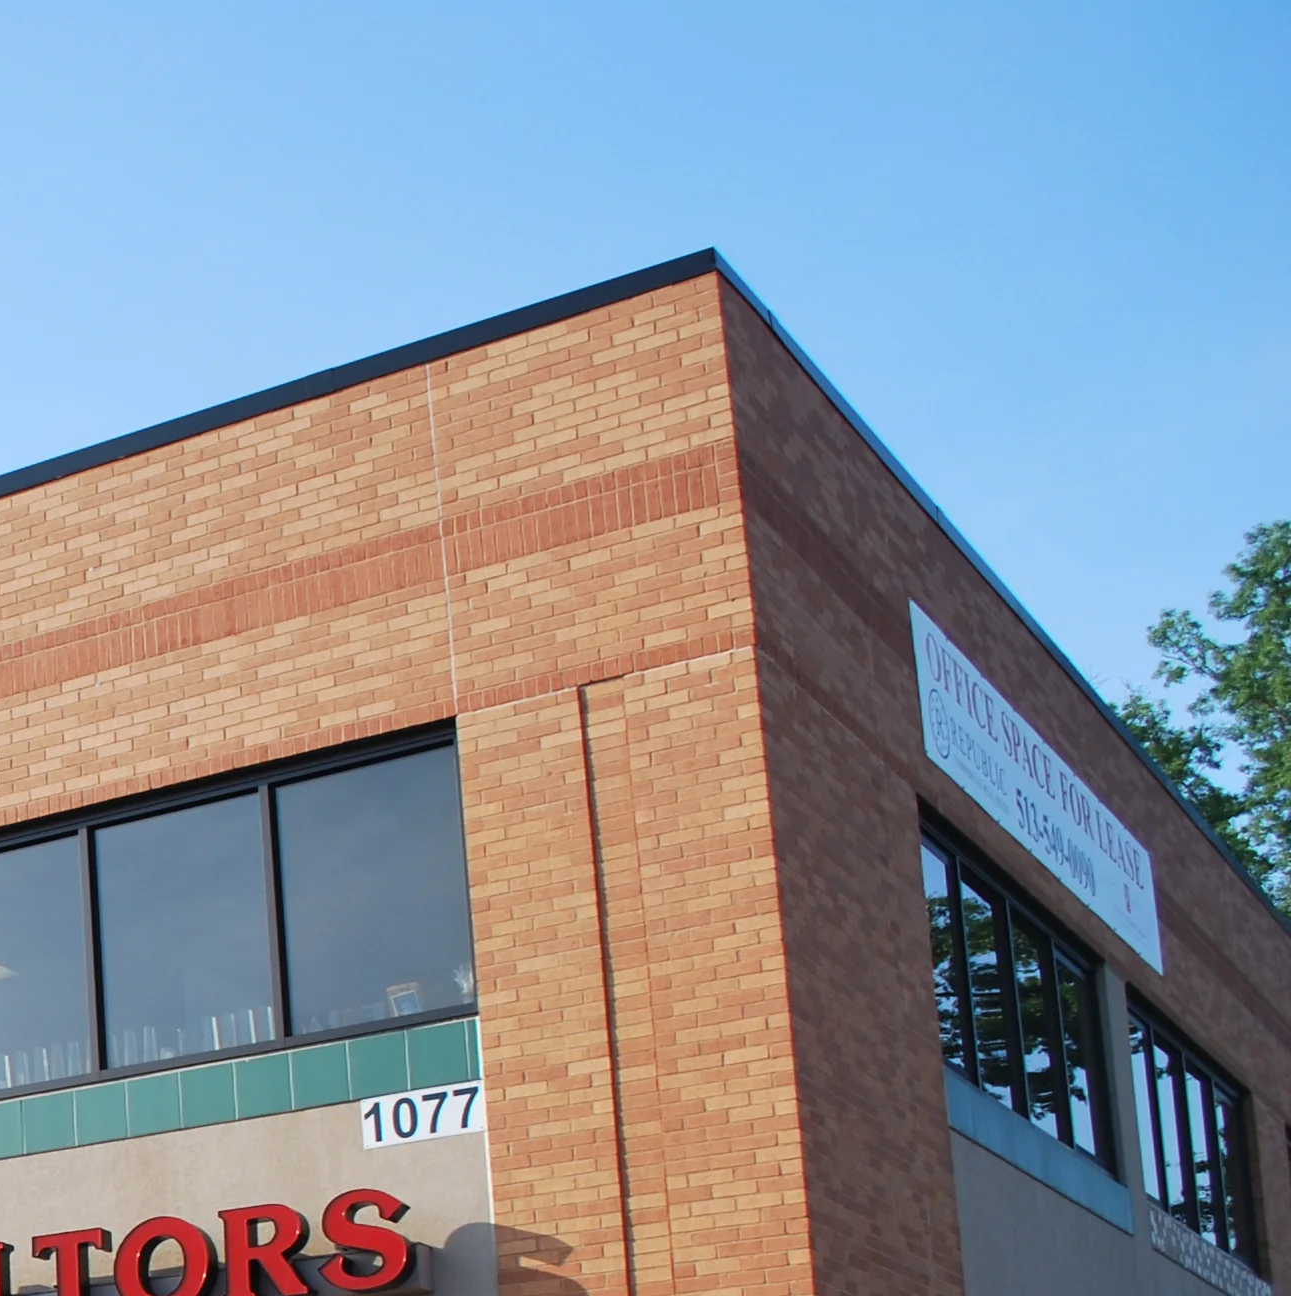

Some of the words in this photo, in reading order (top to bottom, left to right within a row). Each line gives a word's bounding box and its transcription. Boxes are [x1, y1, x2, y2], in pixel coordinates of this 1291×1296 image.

[926, 632, 998, 742] OFFICE
[1001, 711, 1055, 800] SPACE
[1059, 769, 1094, 841] FOR
[1095, 809, 1144, 890] LEASE
[950, 716, 1007, 796] REPUBLIC
[364, 1086, 479, 1142] 1077
